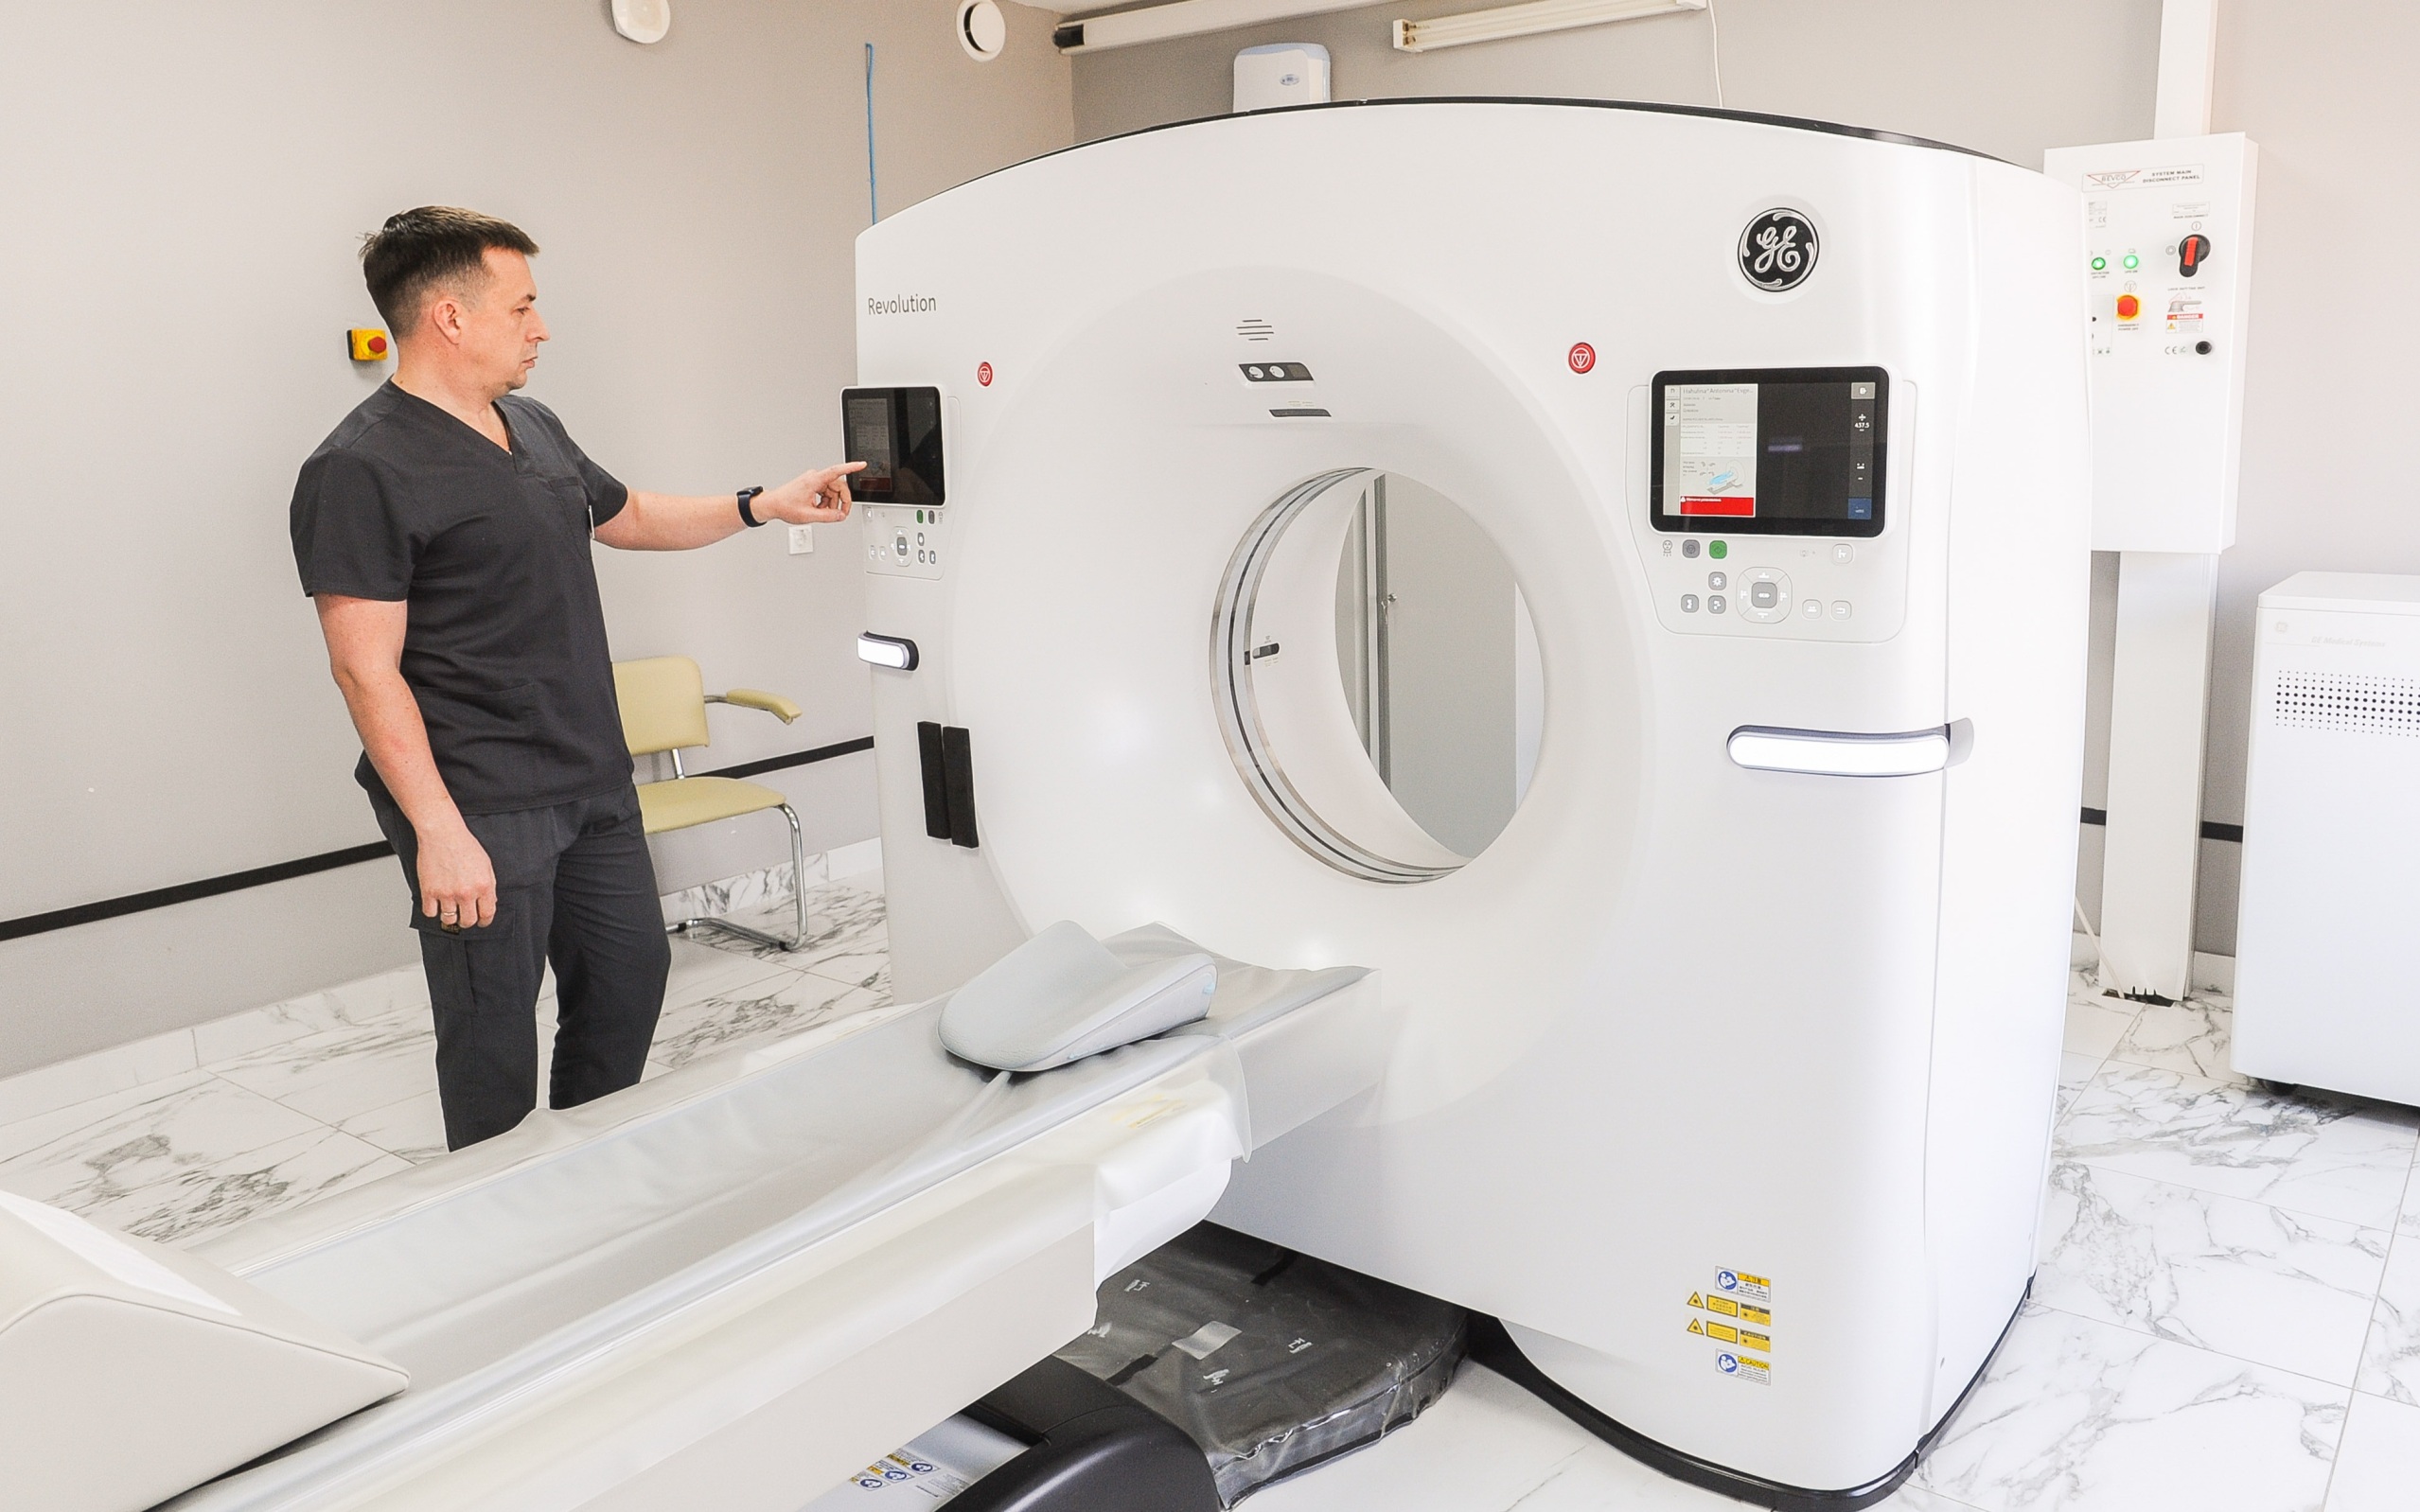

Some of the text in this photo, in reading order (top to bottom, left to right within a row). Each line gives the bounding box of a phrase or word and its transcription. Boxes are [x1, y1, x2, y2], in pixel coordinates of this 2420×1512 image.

[1754, 225, 1801, 273] GE
[868, 293, 937, 315] Revolution
[1745, 1359, 1769, 1369] CAUTION
